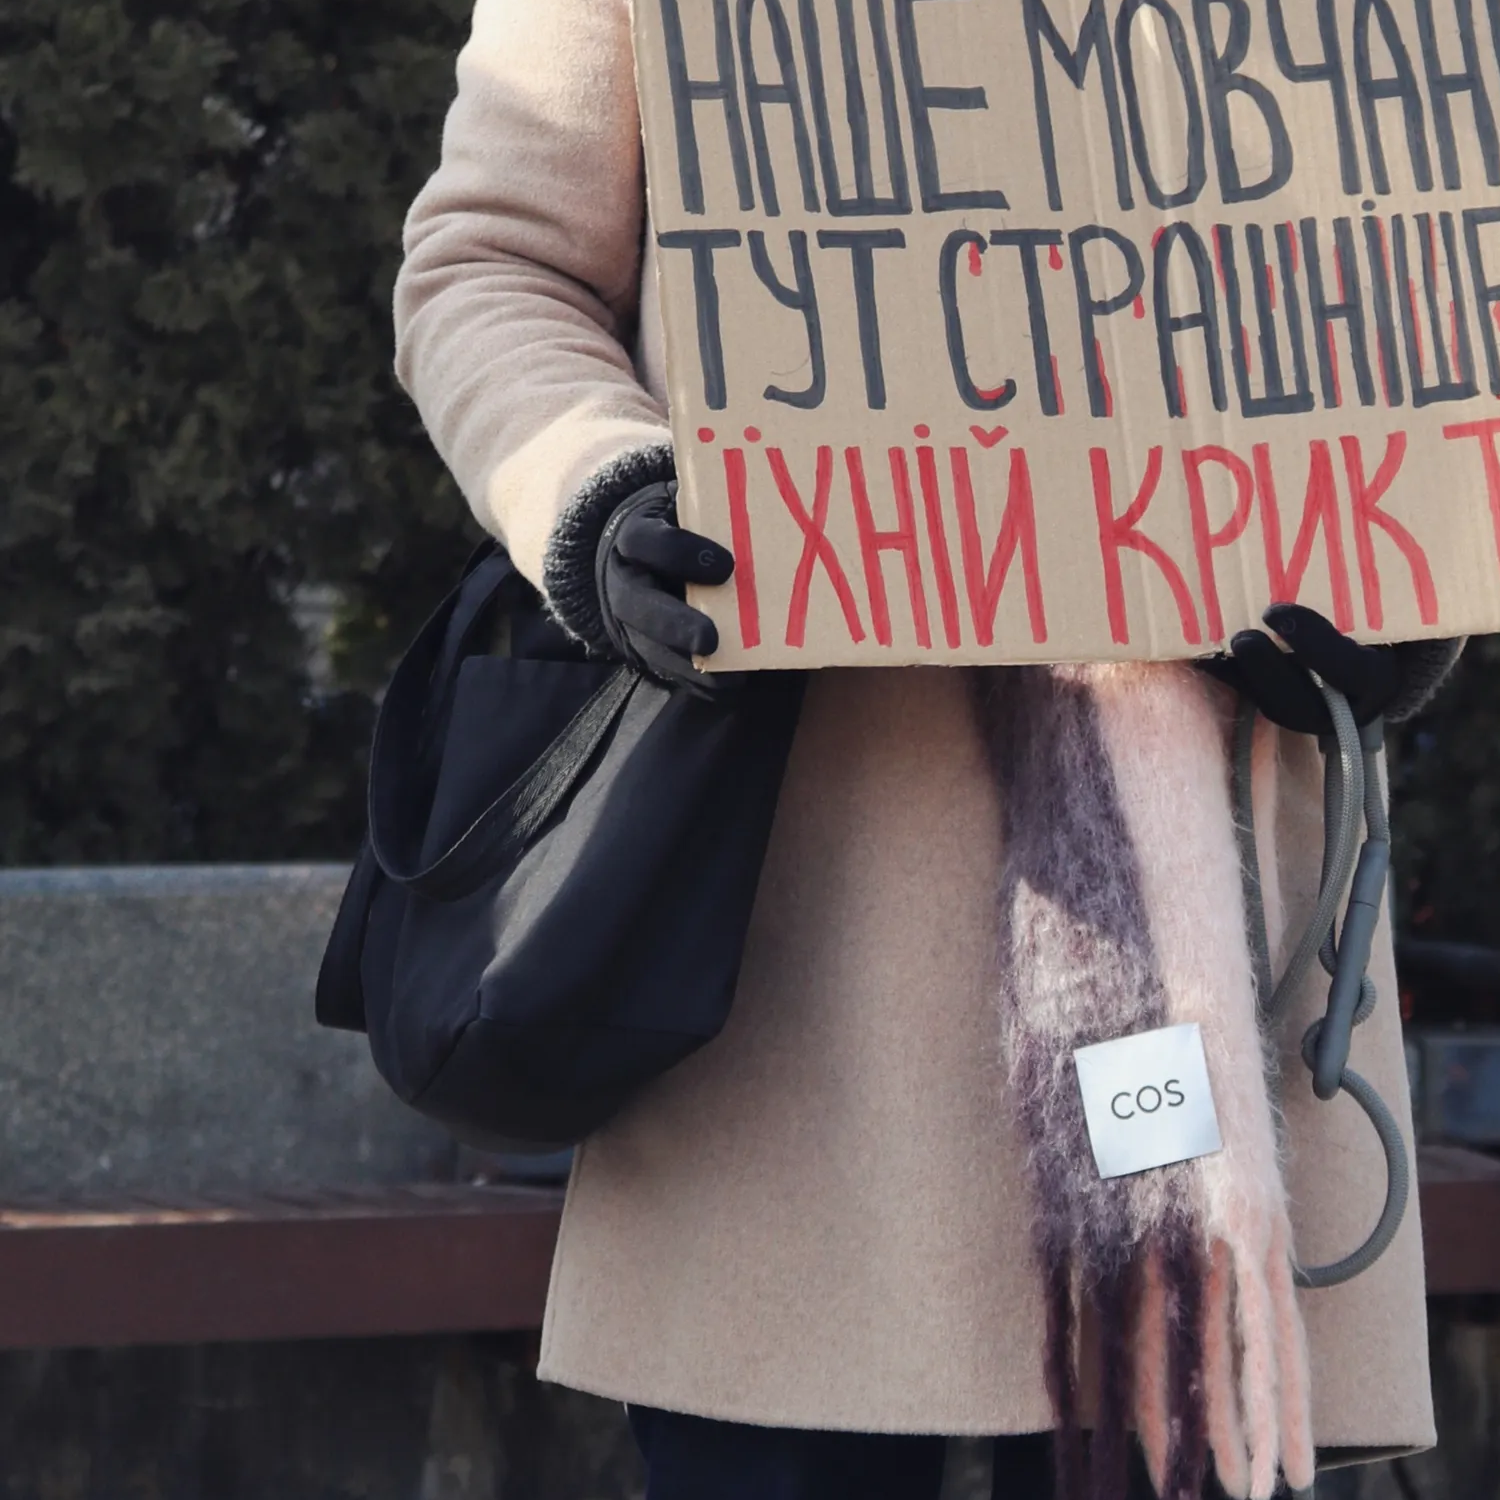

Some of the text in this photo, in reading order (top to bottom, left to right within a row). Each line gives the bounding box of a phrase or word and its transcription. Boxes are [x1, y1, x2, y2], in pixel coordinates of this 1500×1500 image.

[656, 228, 907, 411] ТУТ
[695, 423, 1049, 651] ЇХНІЙ
[1088, 428, 1441, 648] КРИК
[1110, 1078, 1185, 1121] COS
